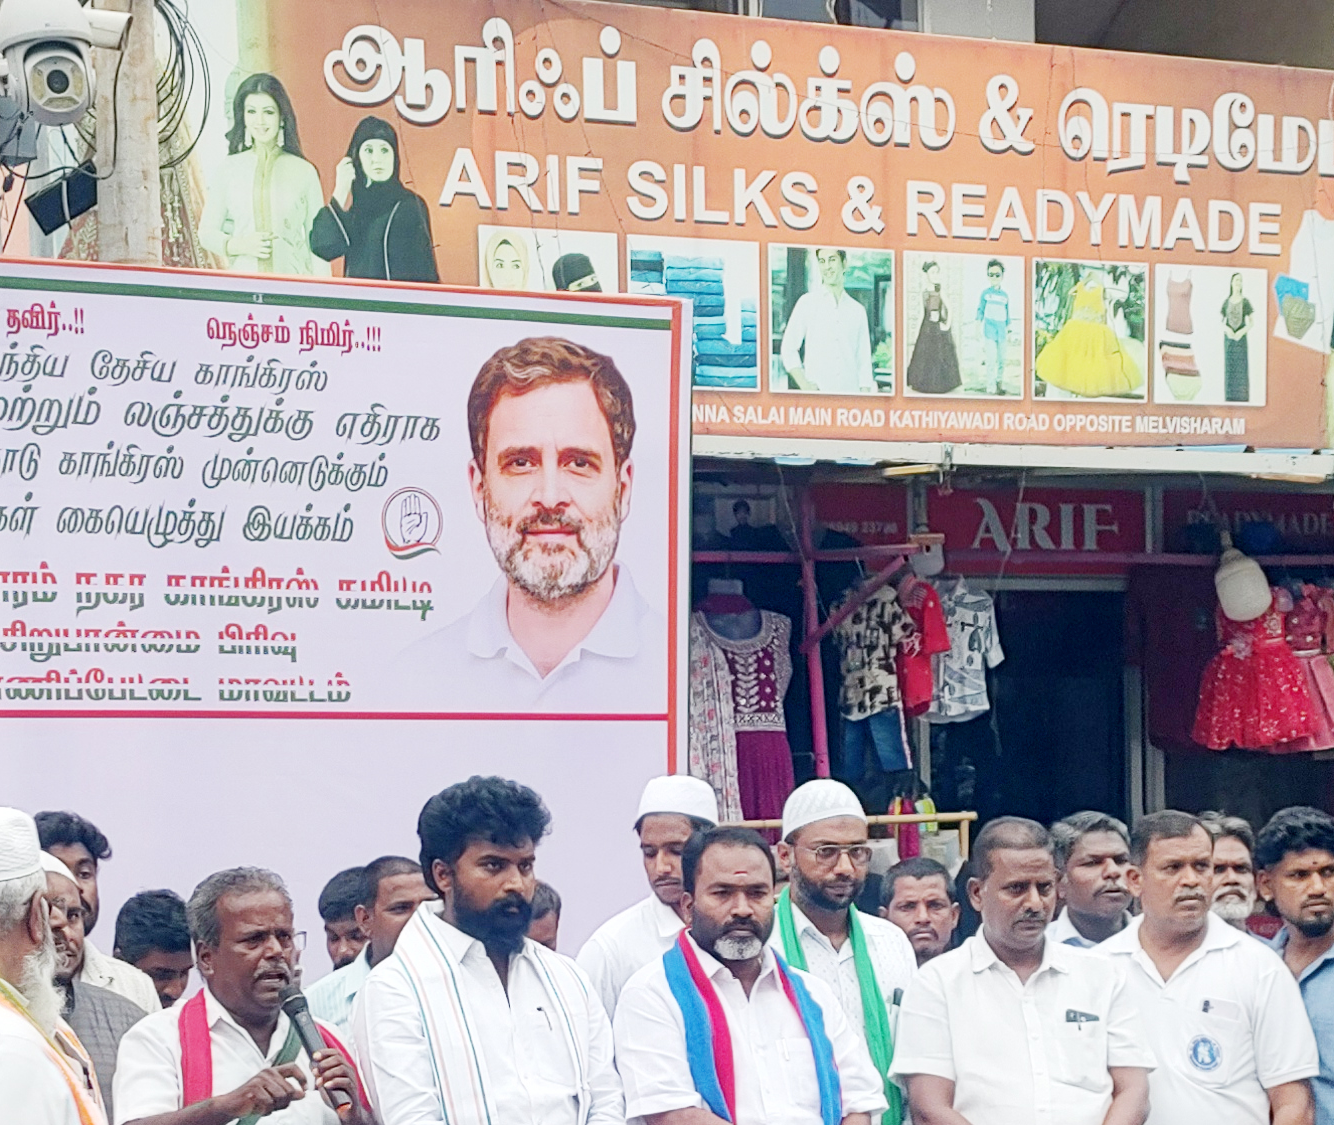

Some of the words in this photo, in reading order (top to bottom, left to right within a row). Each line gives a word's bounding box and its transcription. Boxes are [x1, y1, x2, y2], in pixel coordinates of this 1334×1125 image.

[323, 17, 638, 126] ஆரிஃப்
[661, 38, 956, 151] சில்க்ஸ்
[979, 74, 1036, 155] &
[438, 147, 603, 216] ARIF
[626, 160, 819, 230] SILKS
[841, 175, 885, 235] &
[906, 180, 1282, 256] READYMADE
[206, 312, 289, 351] நெஞ்சம்
[90, 350, 178, 386] தேசிய
[194, 354, 328, 395] காங்கிரஸ்
[124, 390, 314, 442] லஞ்சத்துக்கு
[335, 403, 441, 446] எதிராக
[733, 405, 785, 424] SALAI
[789, 407, 832, 426] MAIN
[836, 408, 886, 428] ROAD
[890, 410, 1000, 430] KATHIYAWADI
[1004, 413, 1050, 431] ROAD
[1053, 414, 1132, 433] OPPOSITE
[1135, 415, 1246, 435] MELVISHARAM
[58, 441, 184, 483] காங்கிரஸ்
[202, 446, 389, 491] முன்னெடுக்கும்
[56, 498, 227, 548] கையெழுத்து
[242, 502, 354, 543] இயக்கம்
[971, 498, 1119, 551] ARIF
